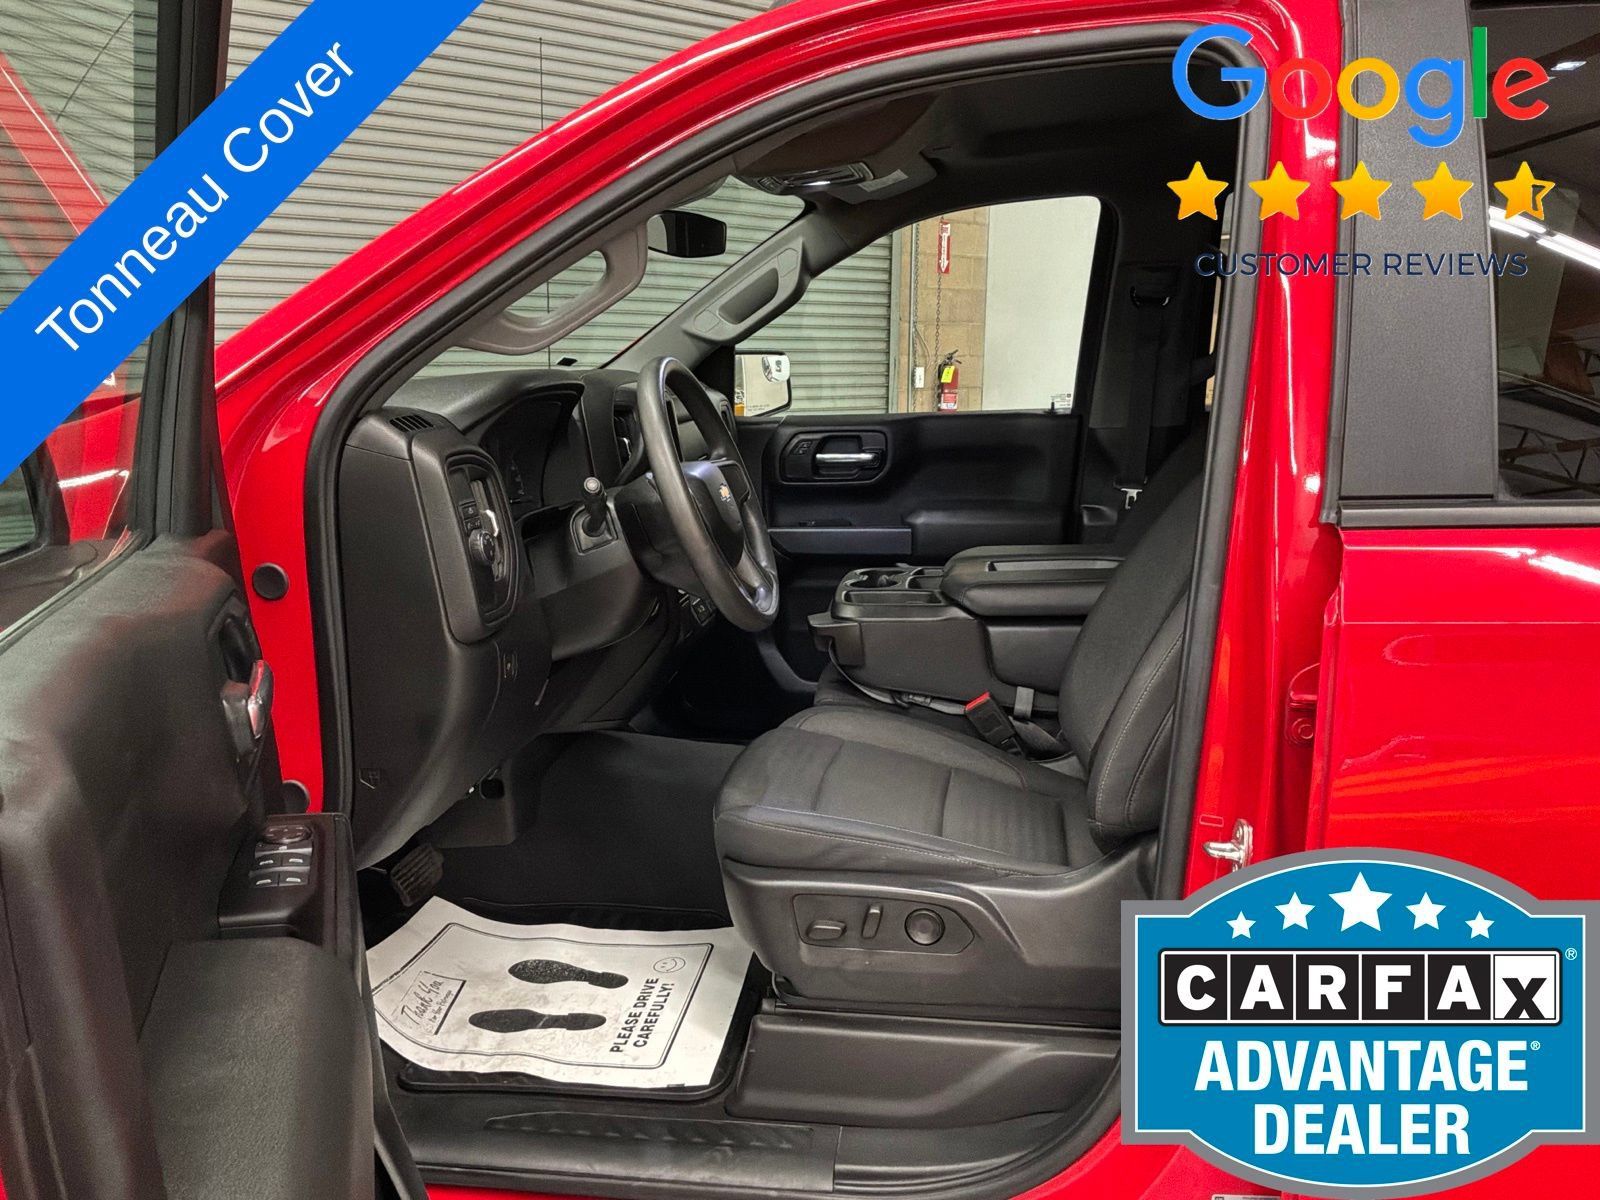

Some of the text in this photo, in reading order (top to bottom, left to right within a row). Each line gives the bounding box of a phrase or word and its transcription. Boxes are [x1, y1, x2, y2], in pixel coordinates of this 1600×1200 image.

[401, 991, 433, 1025] Thank
[609, 978, 659, 1053] PLEASE DRIVE
[633, 983, 675, 1048] CAREFULLY!
